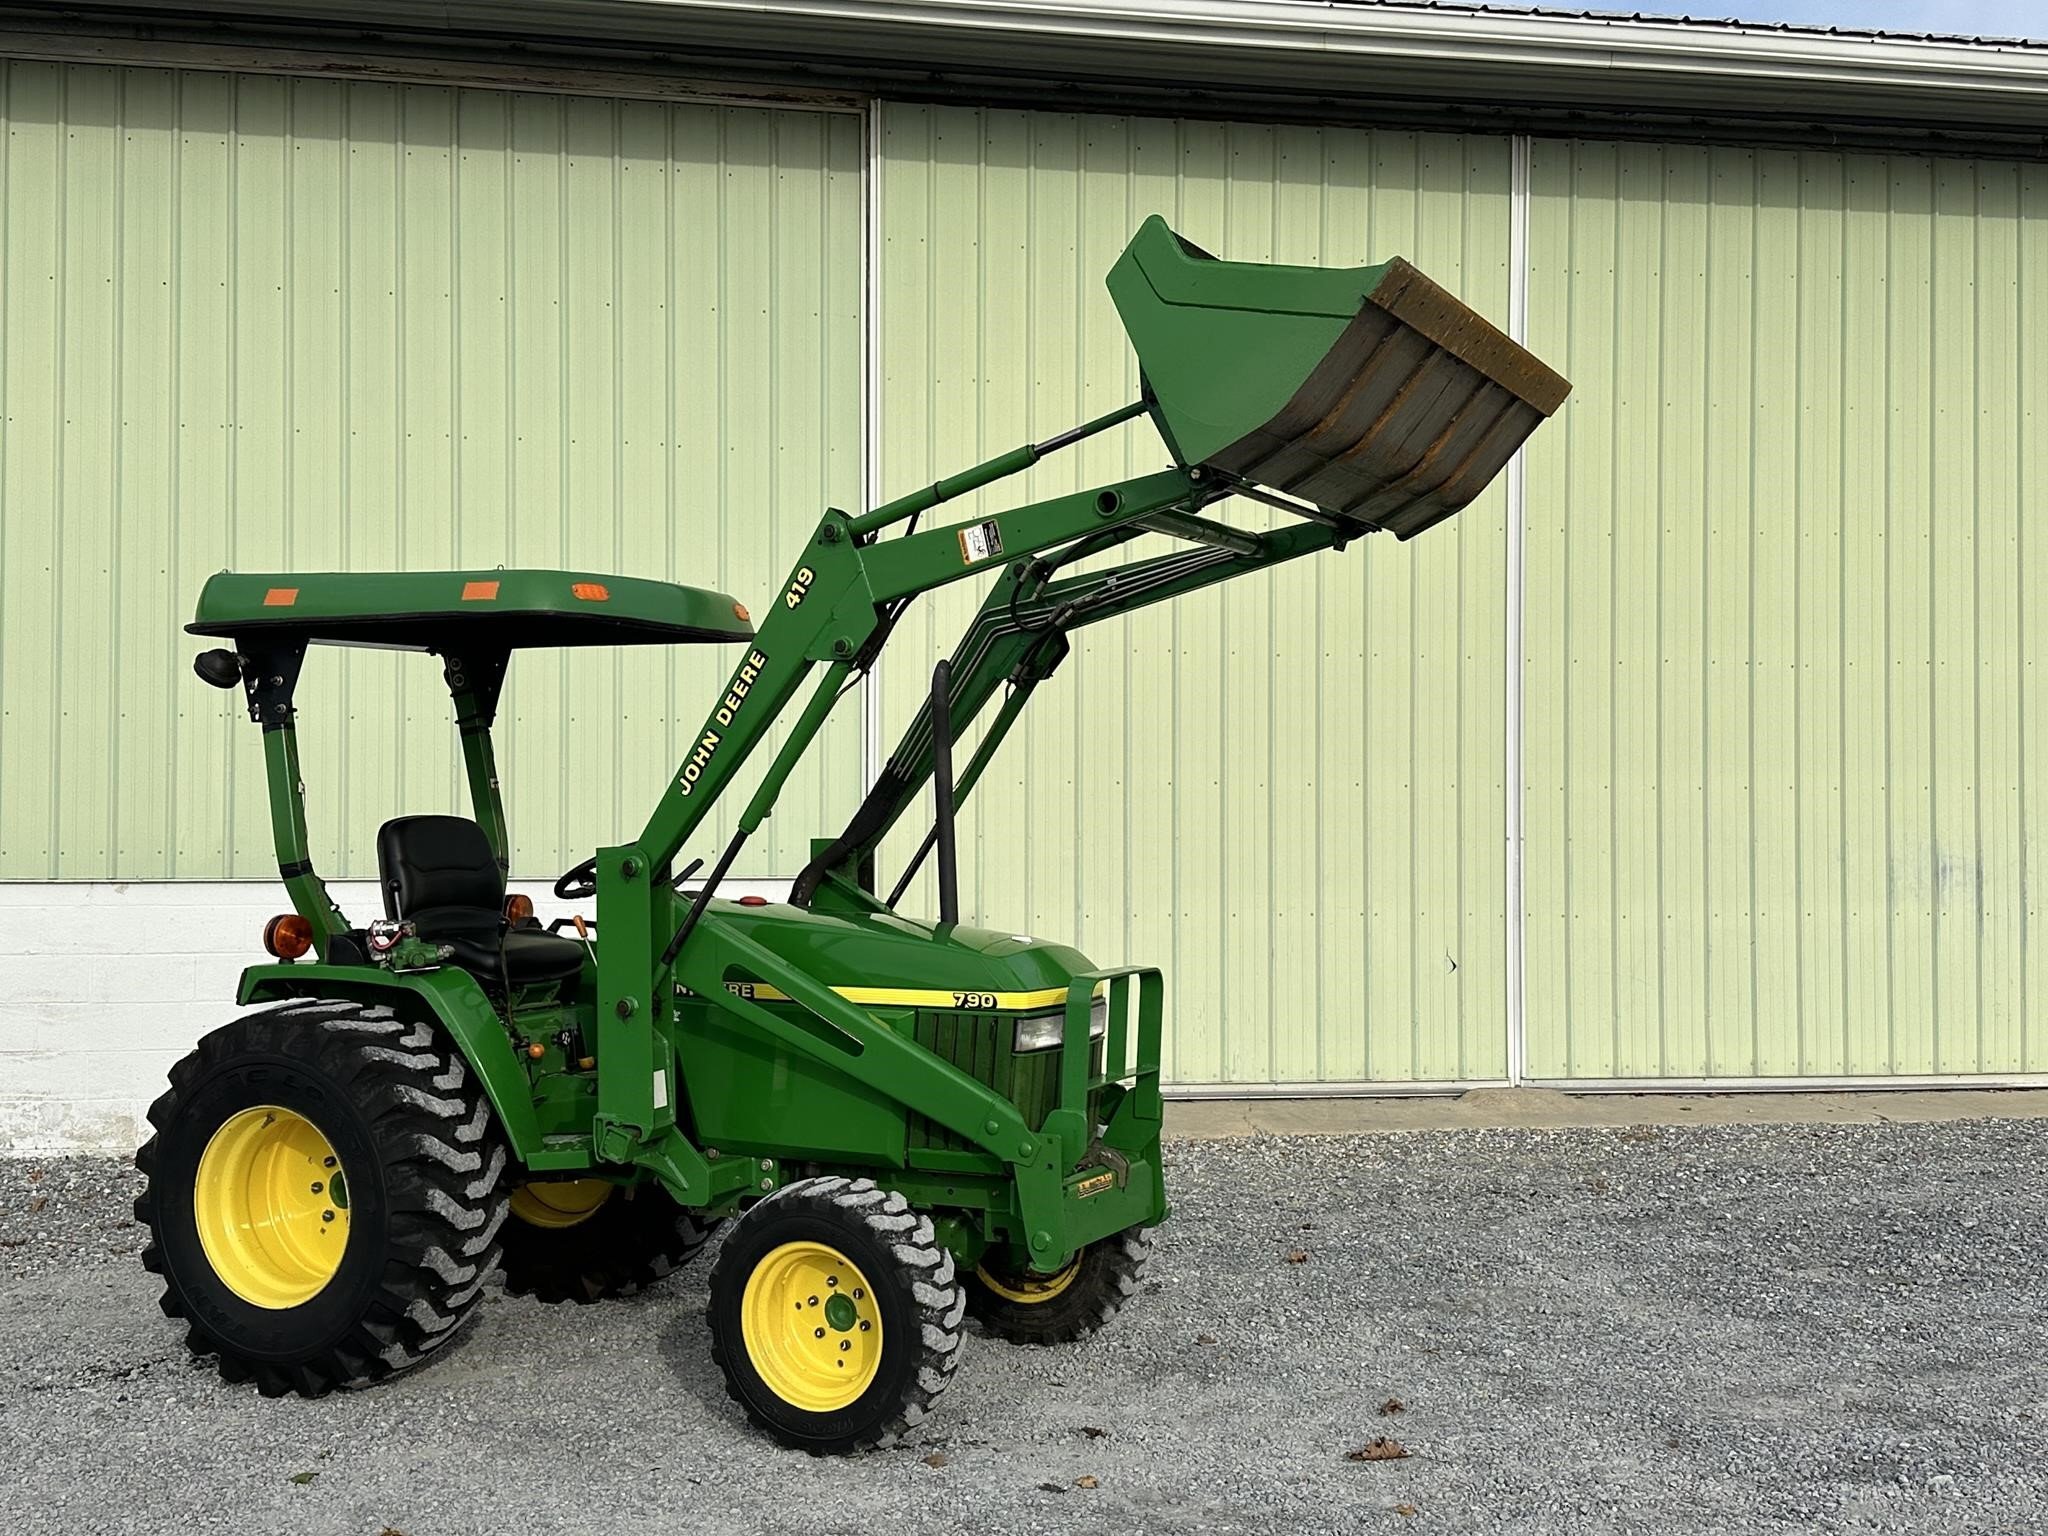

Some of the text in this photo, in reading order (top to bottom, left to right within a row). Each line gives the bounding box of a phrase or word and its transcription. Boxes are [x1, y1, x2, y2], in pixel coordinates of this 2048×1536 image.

[784, 567, 815, 610] 419
[679, 650, 768, 796] JOHN DEERE
[953, 992, 996, 1008] 790
